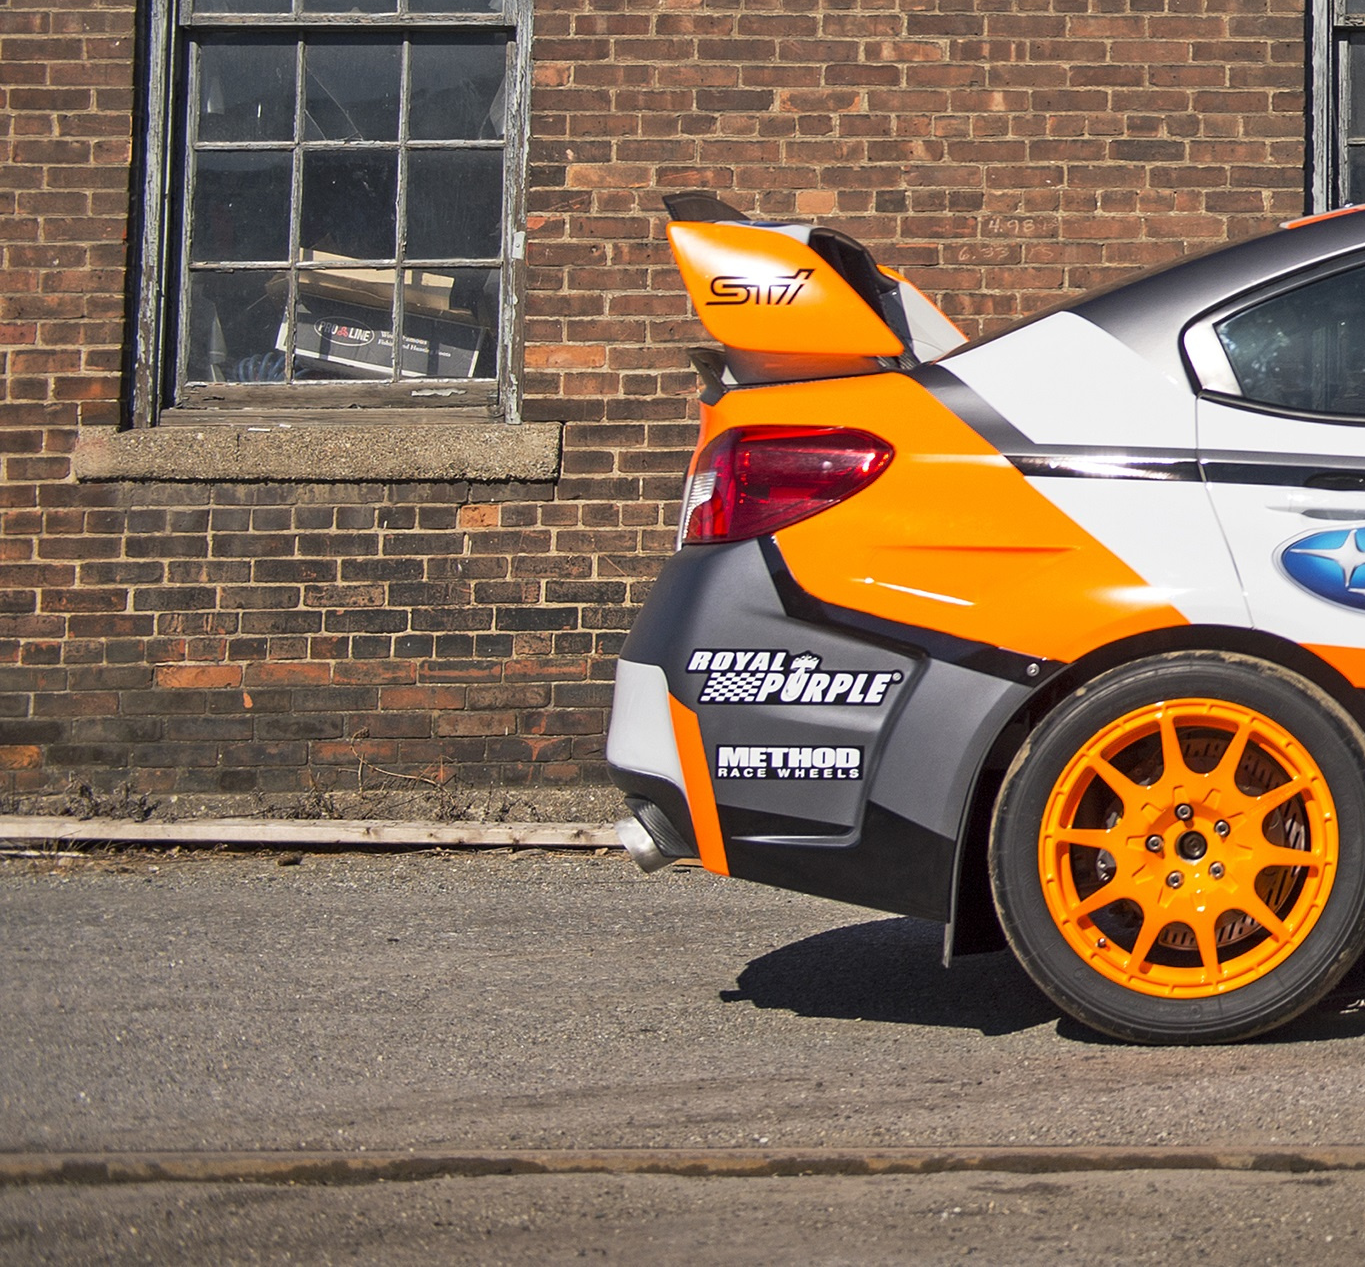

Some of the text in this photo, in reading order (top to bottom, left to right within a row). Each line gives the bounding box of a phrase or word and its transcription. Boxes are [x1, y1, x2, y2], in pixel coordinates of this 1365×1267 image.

[348, 326, 371, 342] LINE
[687, 651, 787, 671] ROYAL
[755, 672, 893, 703] PURPLE
[718, 746, 861, 768] METHOD
[718, 768, 860, 779] RACE WHEELS
